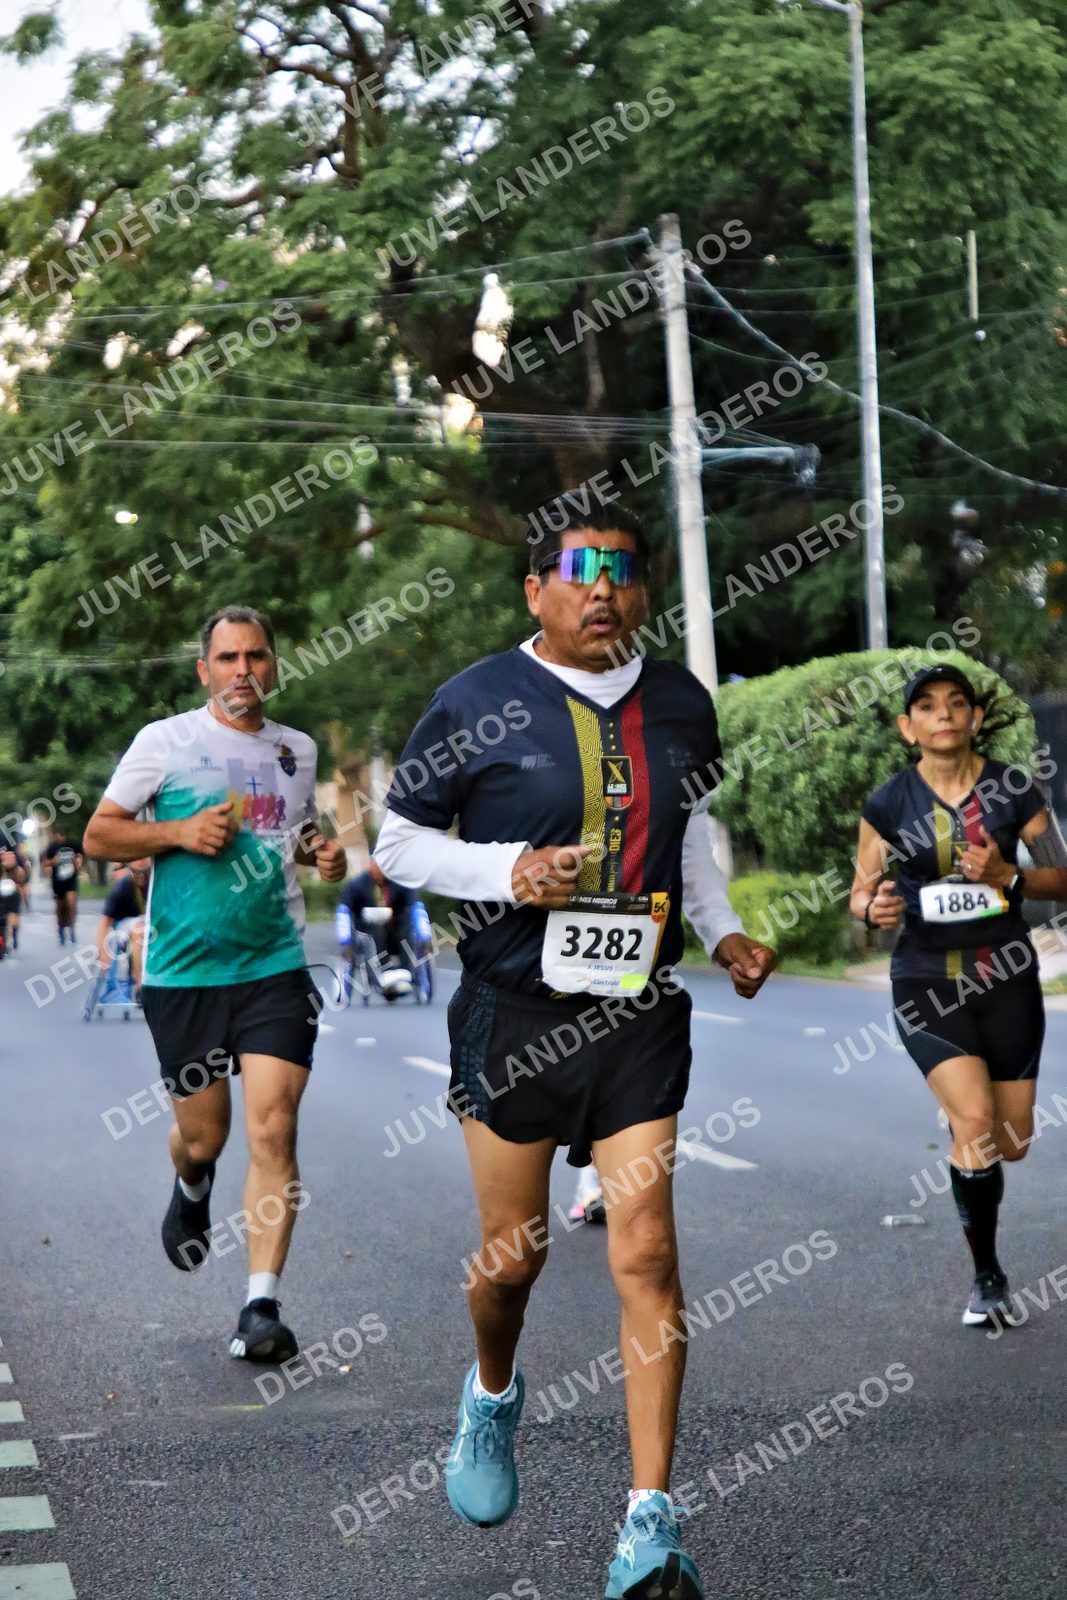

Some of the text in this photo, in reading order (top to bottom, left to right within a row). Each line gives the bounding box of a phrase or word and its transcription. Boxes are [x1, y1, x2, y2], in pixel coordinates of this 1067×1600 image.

[653, 902, 666, 913] 5K
[935, 892, 989, 914] 1884
[560, 924, 643, 961] 3282
